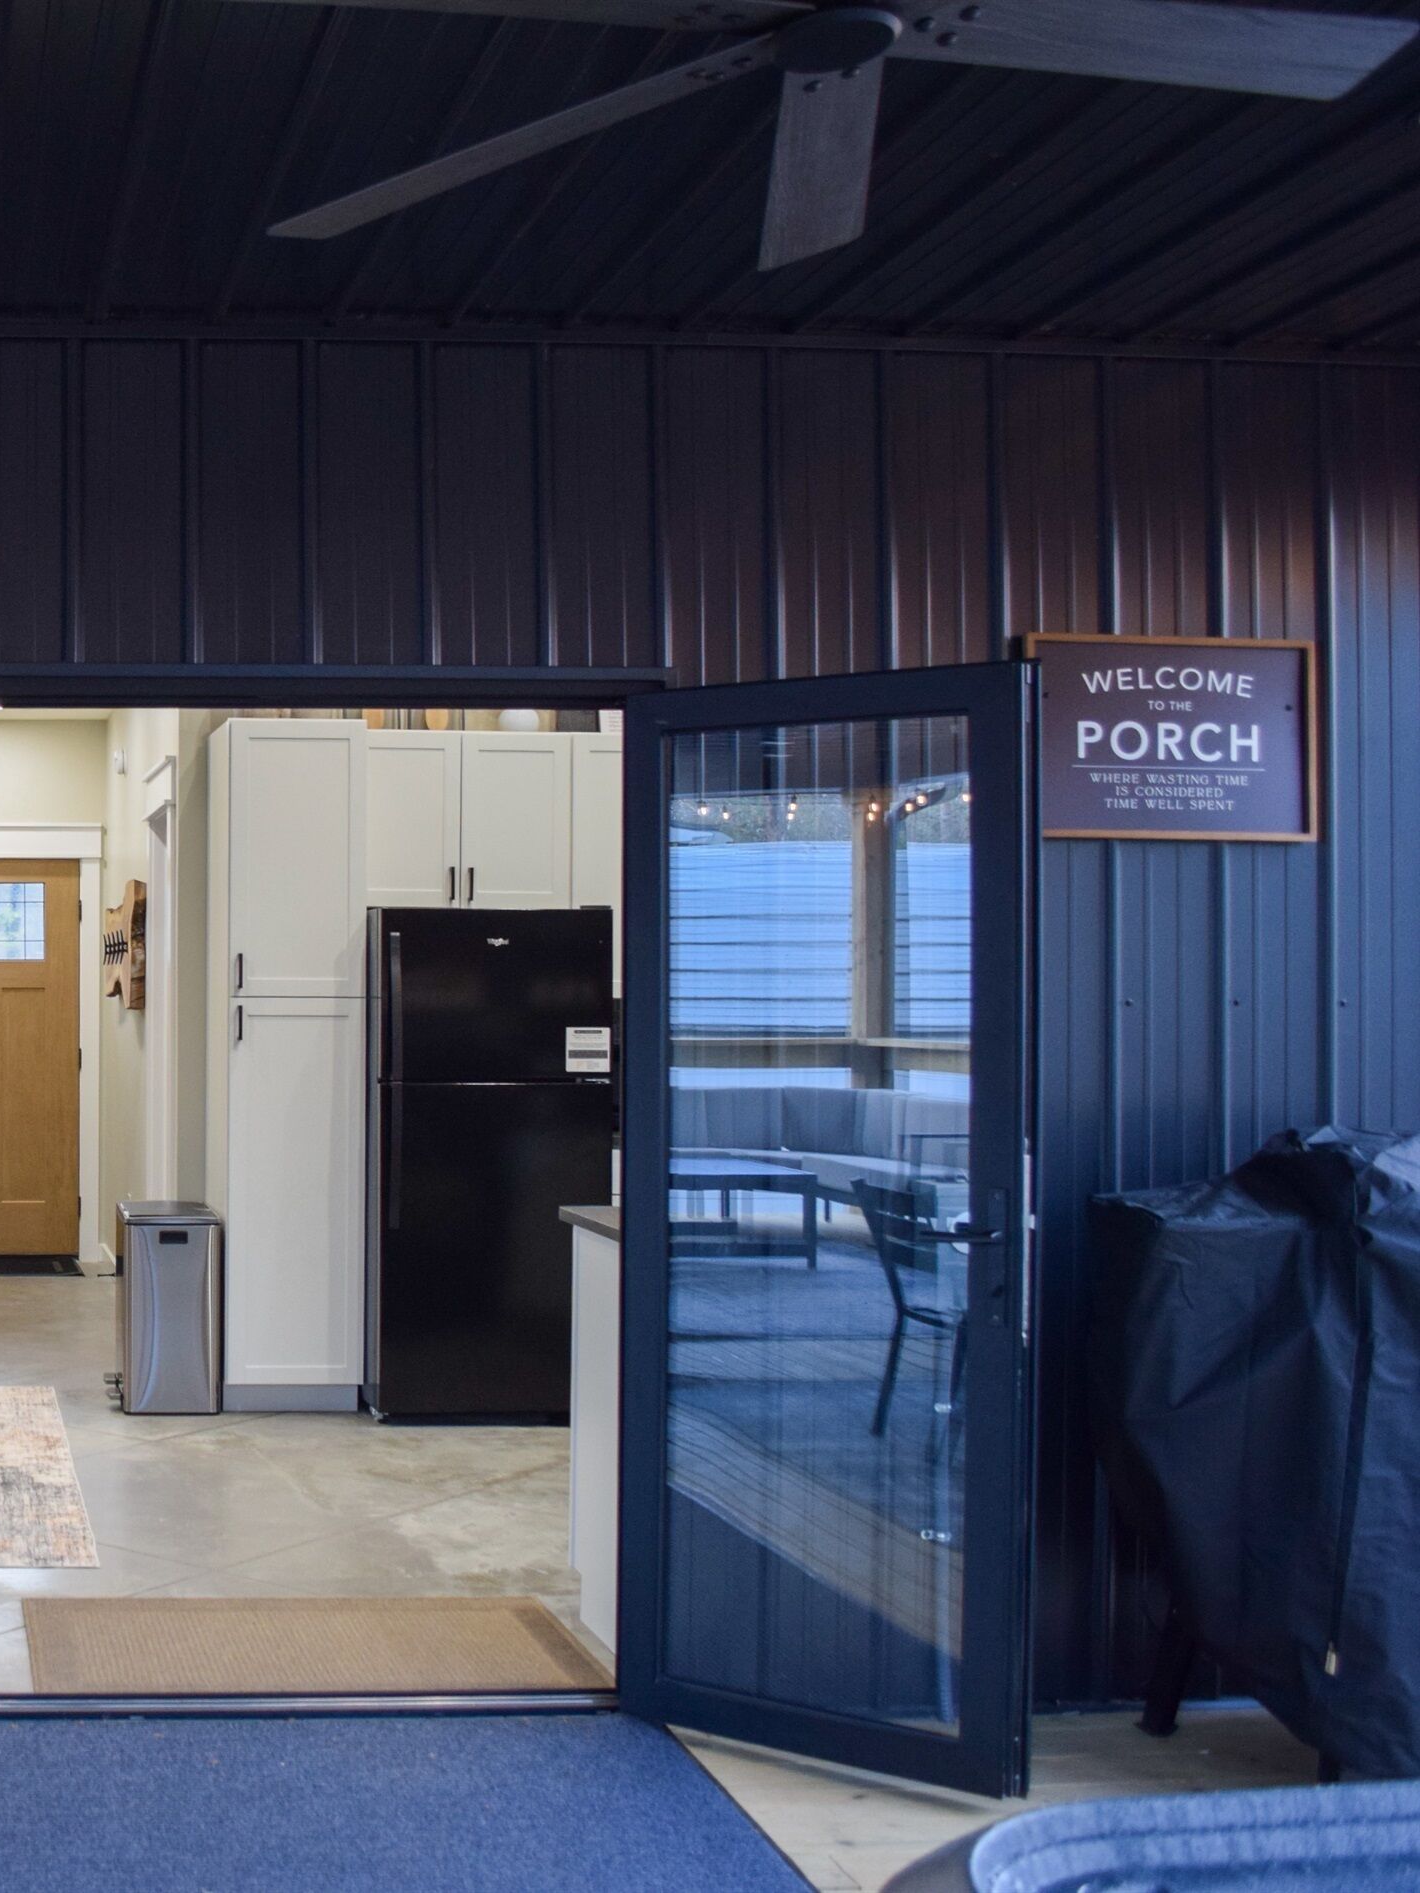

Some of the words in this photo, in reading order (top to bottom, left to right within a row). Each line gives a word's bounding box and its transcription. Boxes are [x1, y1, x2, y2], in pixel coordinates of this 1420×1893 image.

[1081, 666, 1254, 698] WELCOME
[1147, 700, 1165, 711] TO
[1169, 700, 1193, 712] THE
[1077, 720, 1259, 762] PORCH
[1089, 772, 1140, 784] WHERE
[1146, 773, 1209, 785] WASTING
[1215, 775, 1249, 786] TIME
[1115, 785, 1129, 796] IS
[1134, 786, 1224, 798] CONSIDERED
[1103, 798, 1138, 809] TIME
[1144, 799, 1184, 810] WELL
[1189, 799, 1235, 811] SPENT
